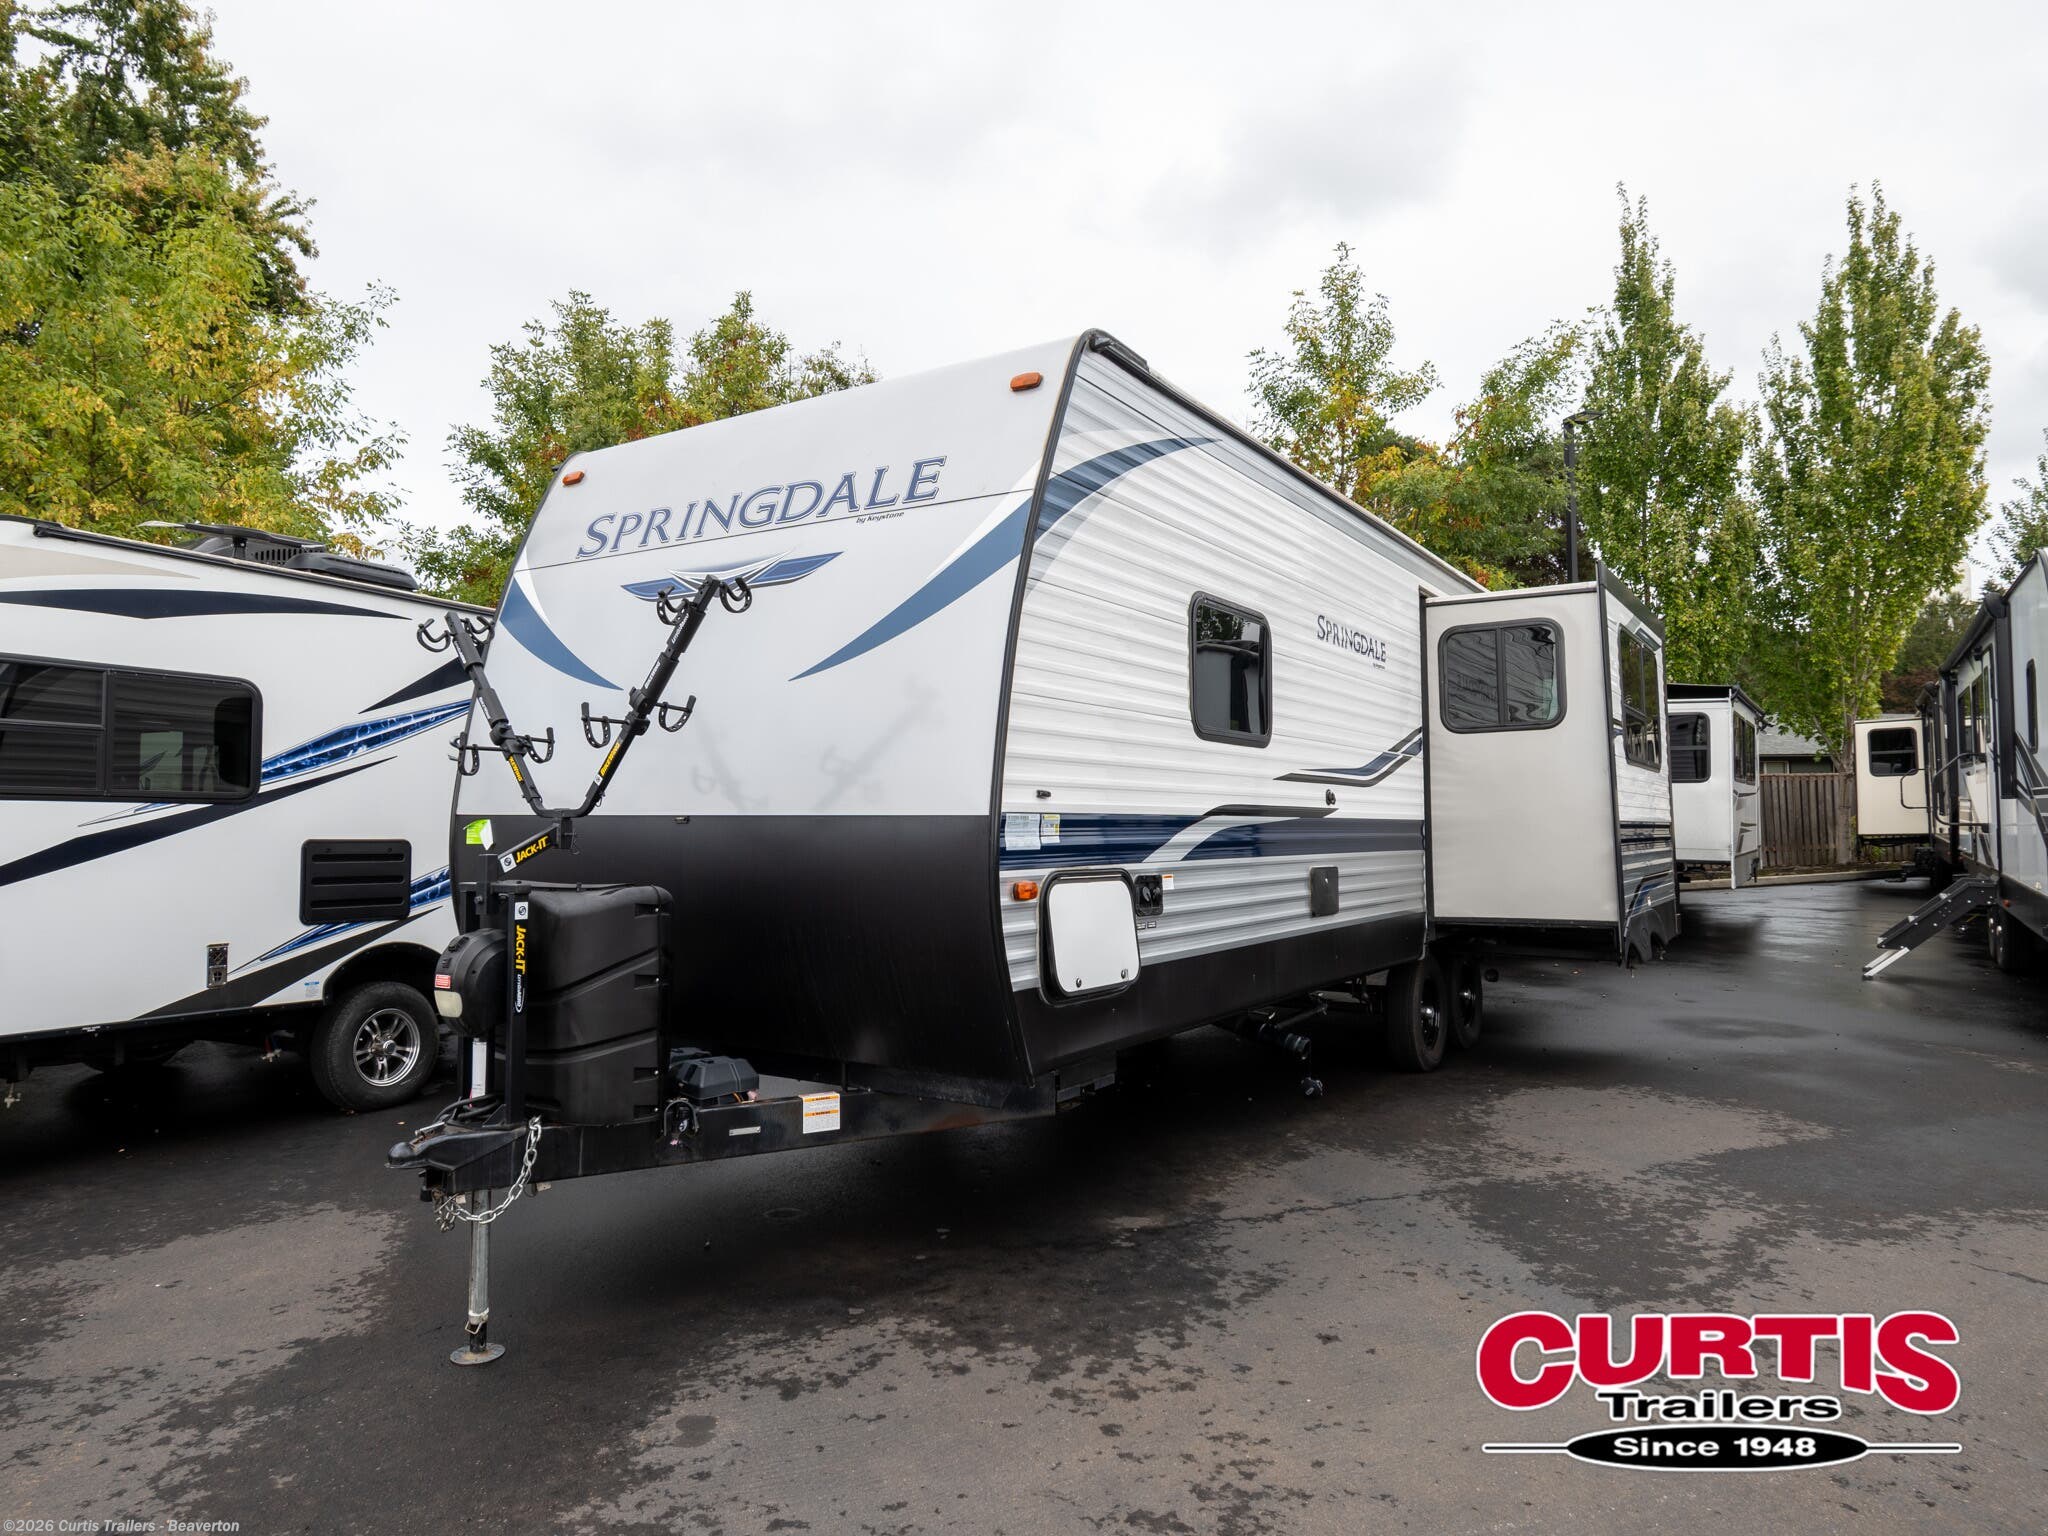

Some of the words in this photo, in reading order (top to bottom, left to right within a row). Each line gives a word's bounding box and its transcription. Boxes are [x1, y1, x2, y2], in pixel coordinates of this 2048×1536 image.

[576, 455, 948, 560] SPRINGDALE
[1316, 614, 1387, 663] SPRINGDALE
[516, 835, 549, 864] JACK-IT
[515, 924, 526, 975] JACK-IT
